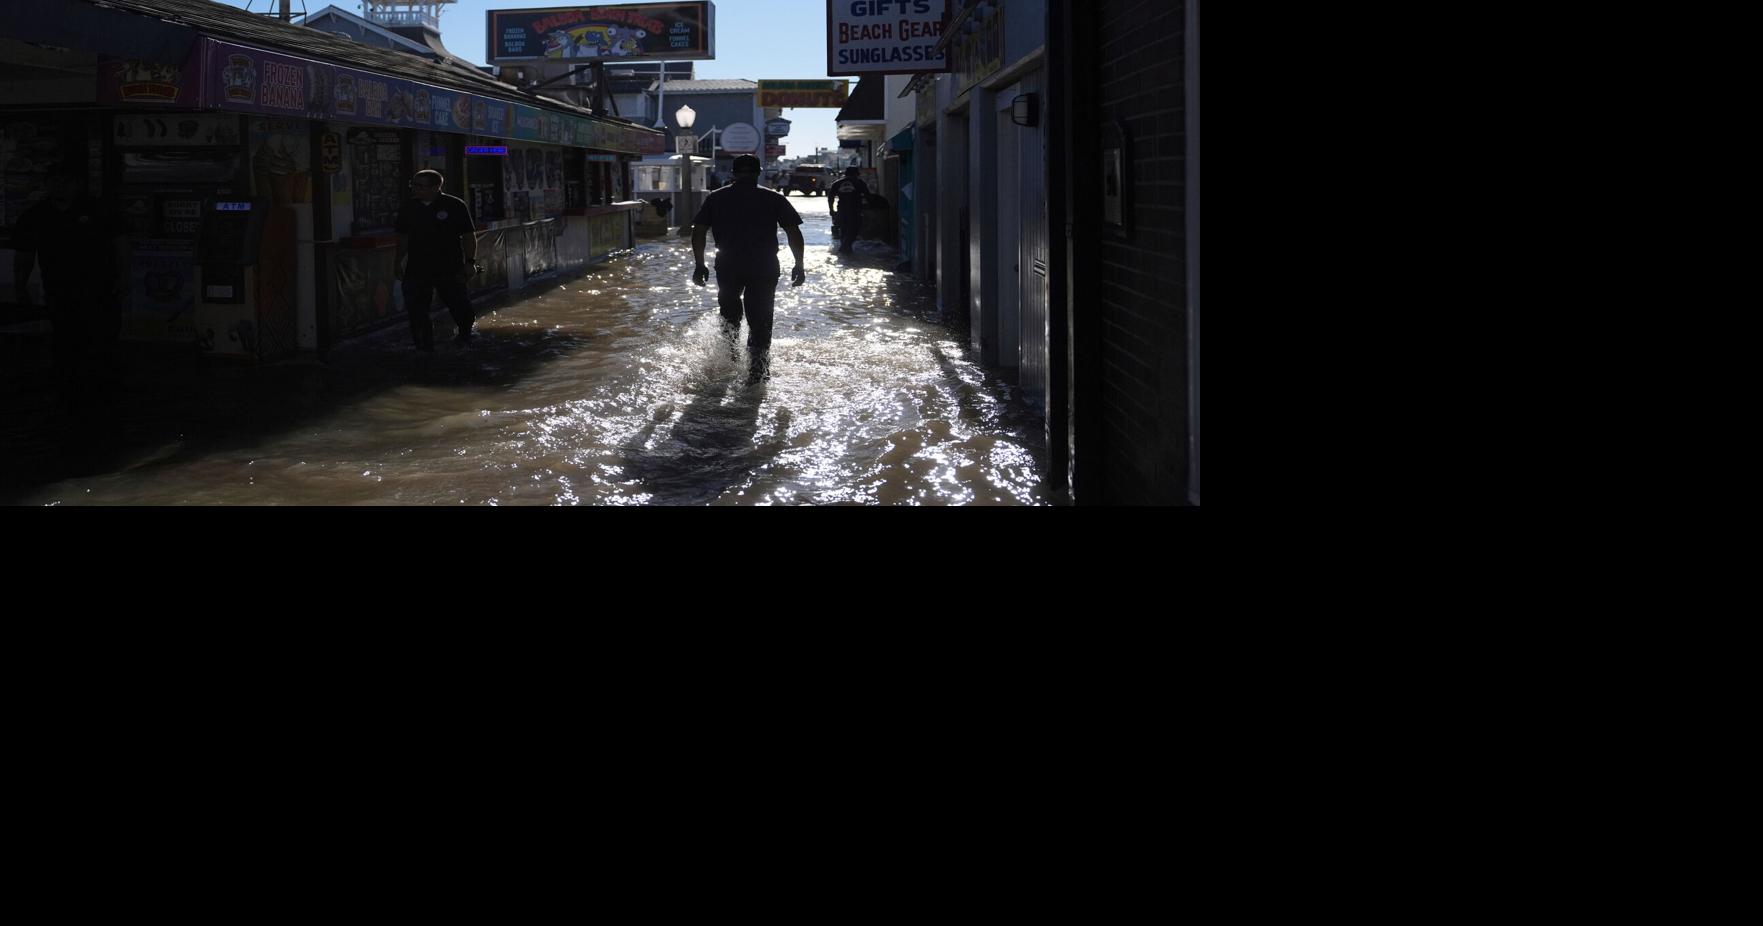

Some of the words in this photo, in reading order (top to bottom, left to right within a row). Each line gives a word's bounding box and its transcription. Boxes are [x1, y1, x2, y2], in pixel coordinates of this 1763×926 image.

[850, 0, 930, 17] GIFTS
[838, 22, 892, 44] BEACH
[899, 19, 944, 42] GEAR
[838, 45, 945, 65] SUNGLASSES
[263, 60, 305, 88] FROZEN
[260, 83, 305, 111] BANANA
[321, 134, 339, 165] ATM
